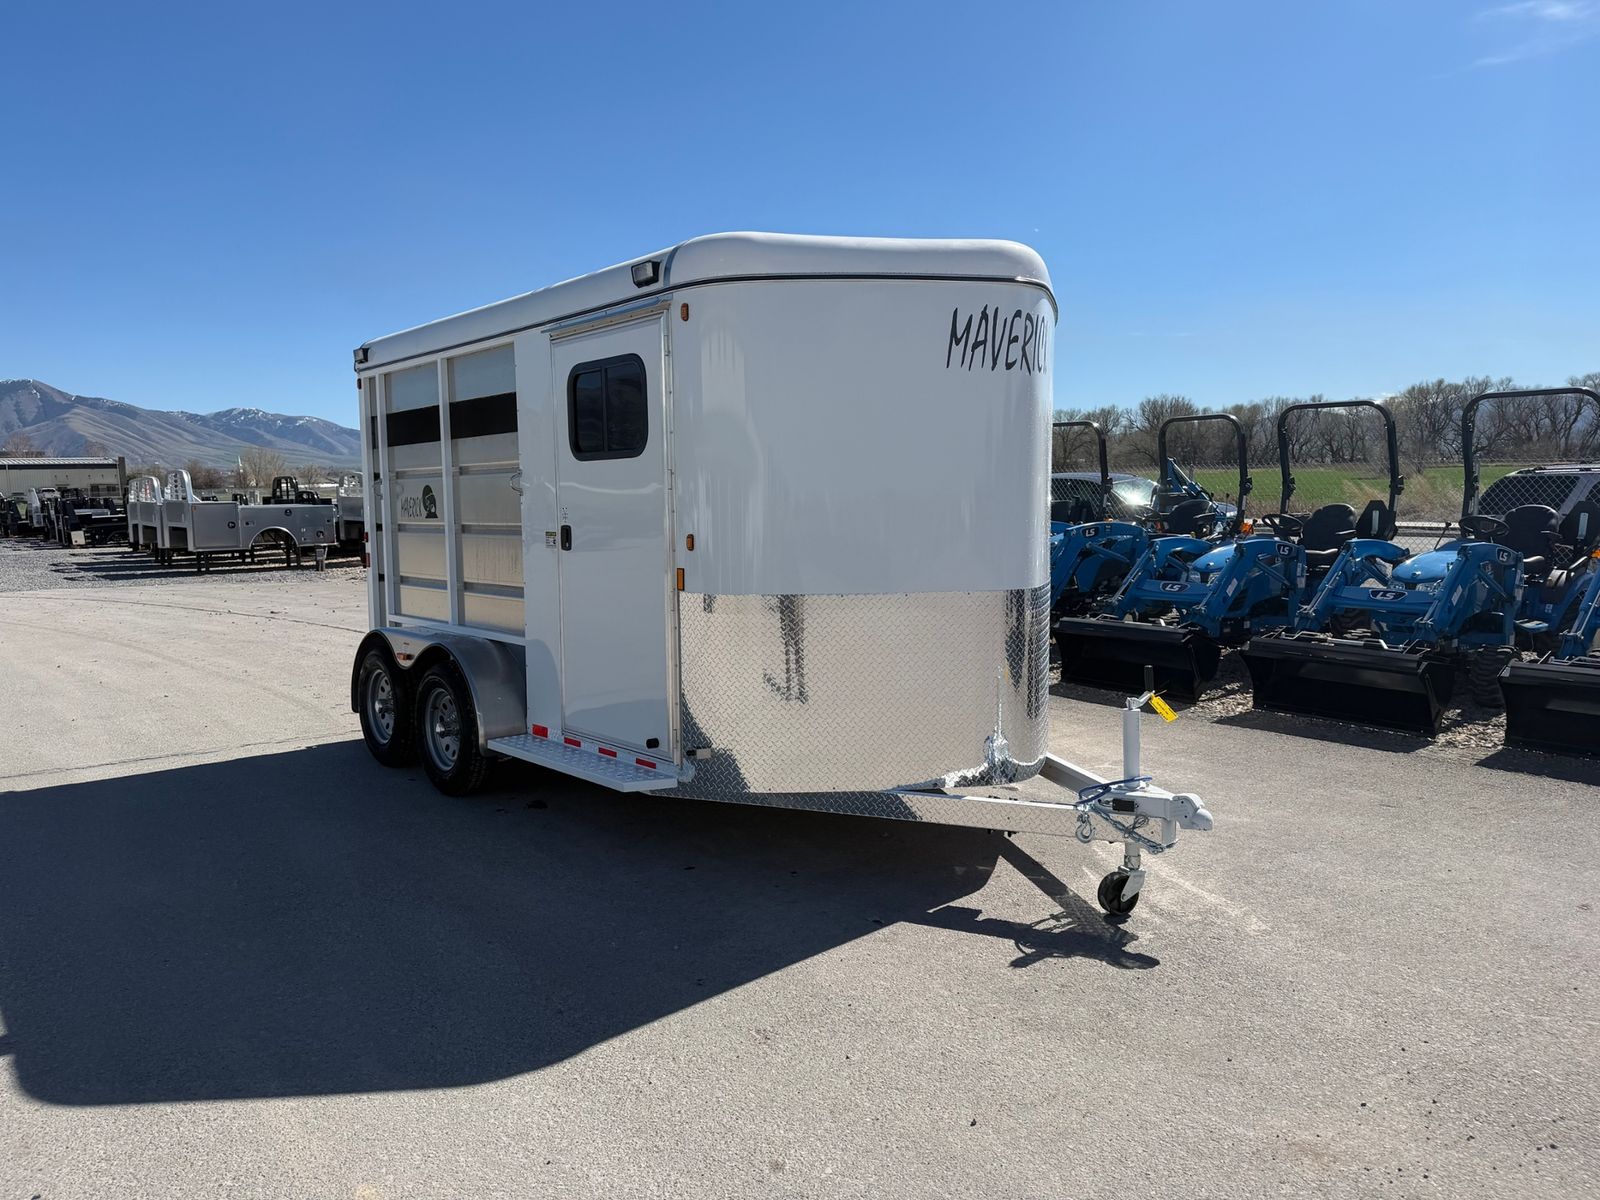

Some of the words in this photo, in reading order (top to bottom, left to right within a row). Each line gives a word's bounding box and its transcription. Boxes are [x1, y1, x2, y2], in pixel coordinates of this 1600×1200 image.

[1085, 528, 1095, 537] LS
[1280, 545, 1289, 555] LS
[1499, 551, 1508, 562] LS
[1165, 583, 1181, 591] LS
[1376, 591, 1396, 600] LS
